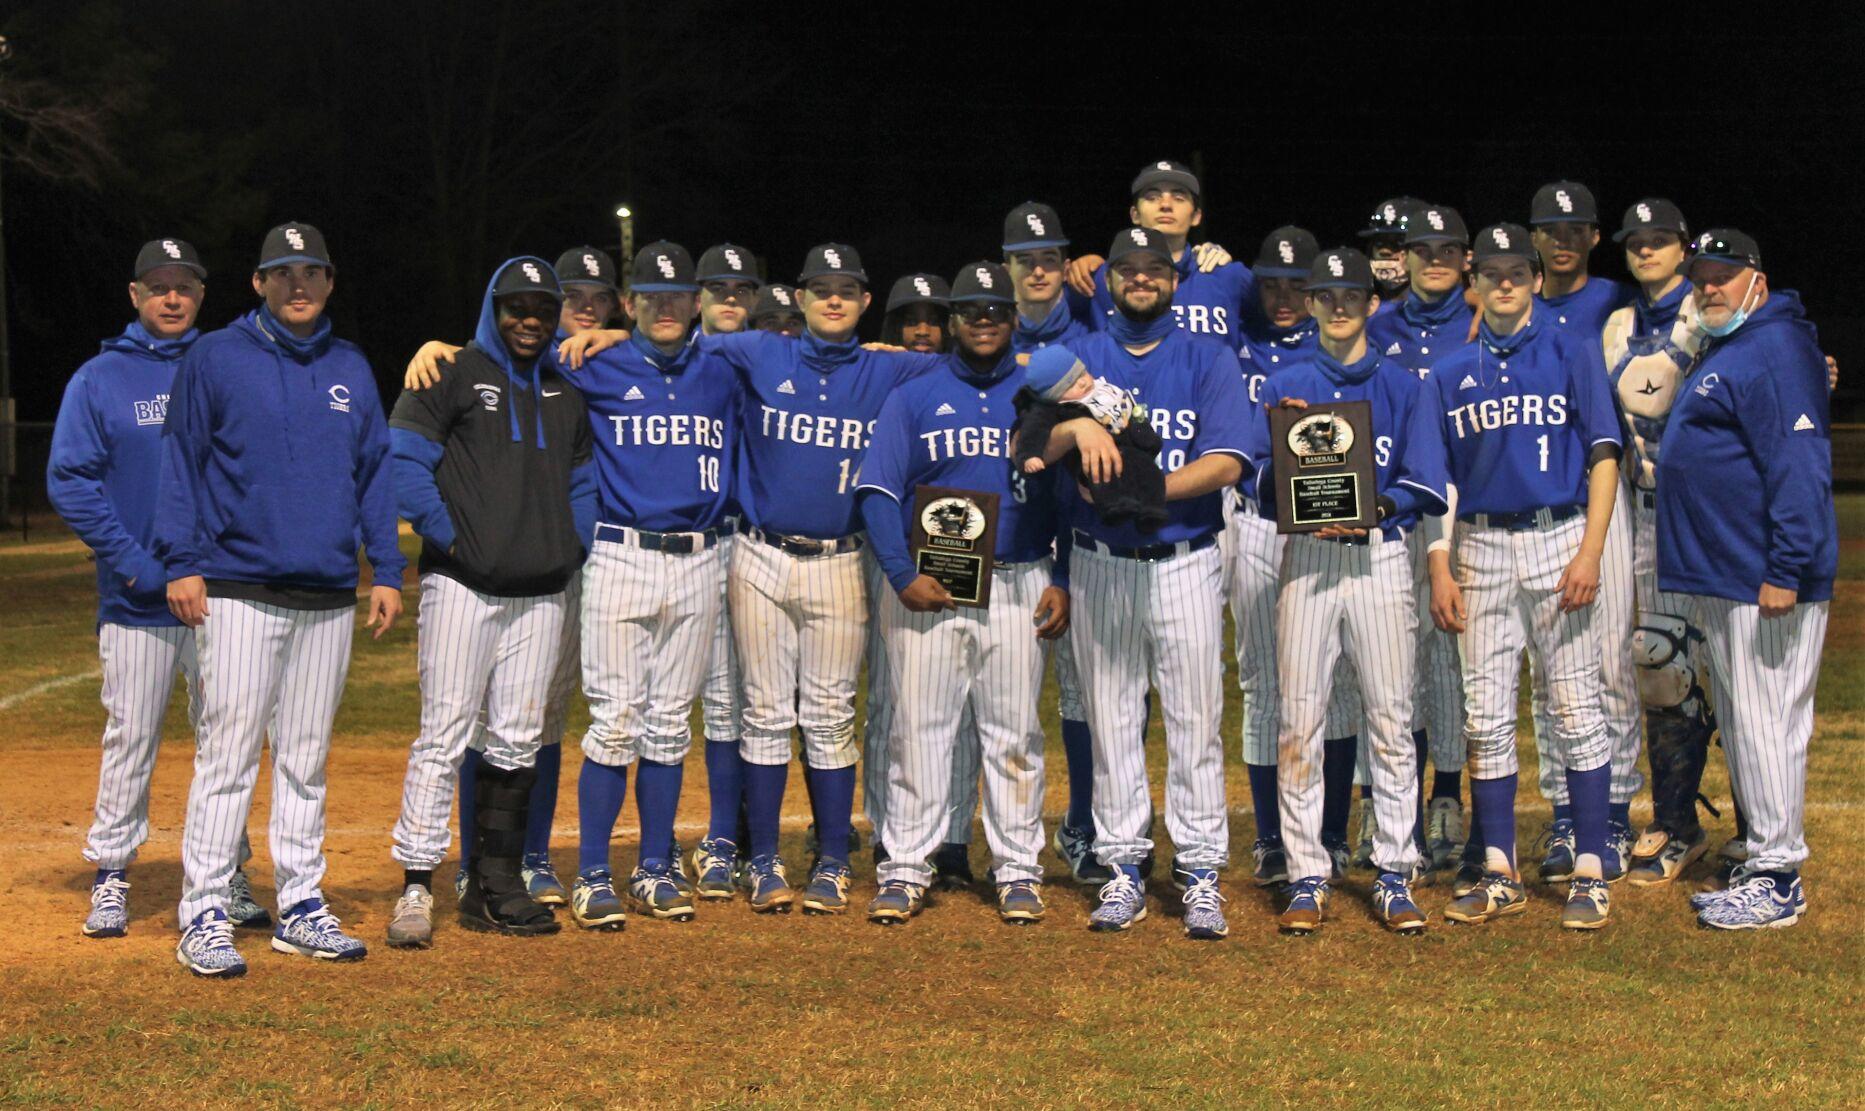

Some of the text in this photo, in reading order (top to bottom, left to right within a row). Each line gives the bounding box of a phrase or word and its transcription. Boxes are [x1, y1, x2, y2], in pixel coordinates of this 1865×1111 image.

[608, 414, 724, 449] TIGERS
[1447, 394, 1567, 439] TIGERS
[1305, 456, 1339, 464] BASEBALL
[1536, 434, 1549, 472] 1
[697, 454, 720, 493] 10
